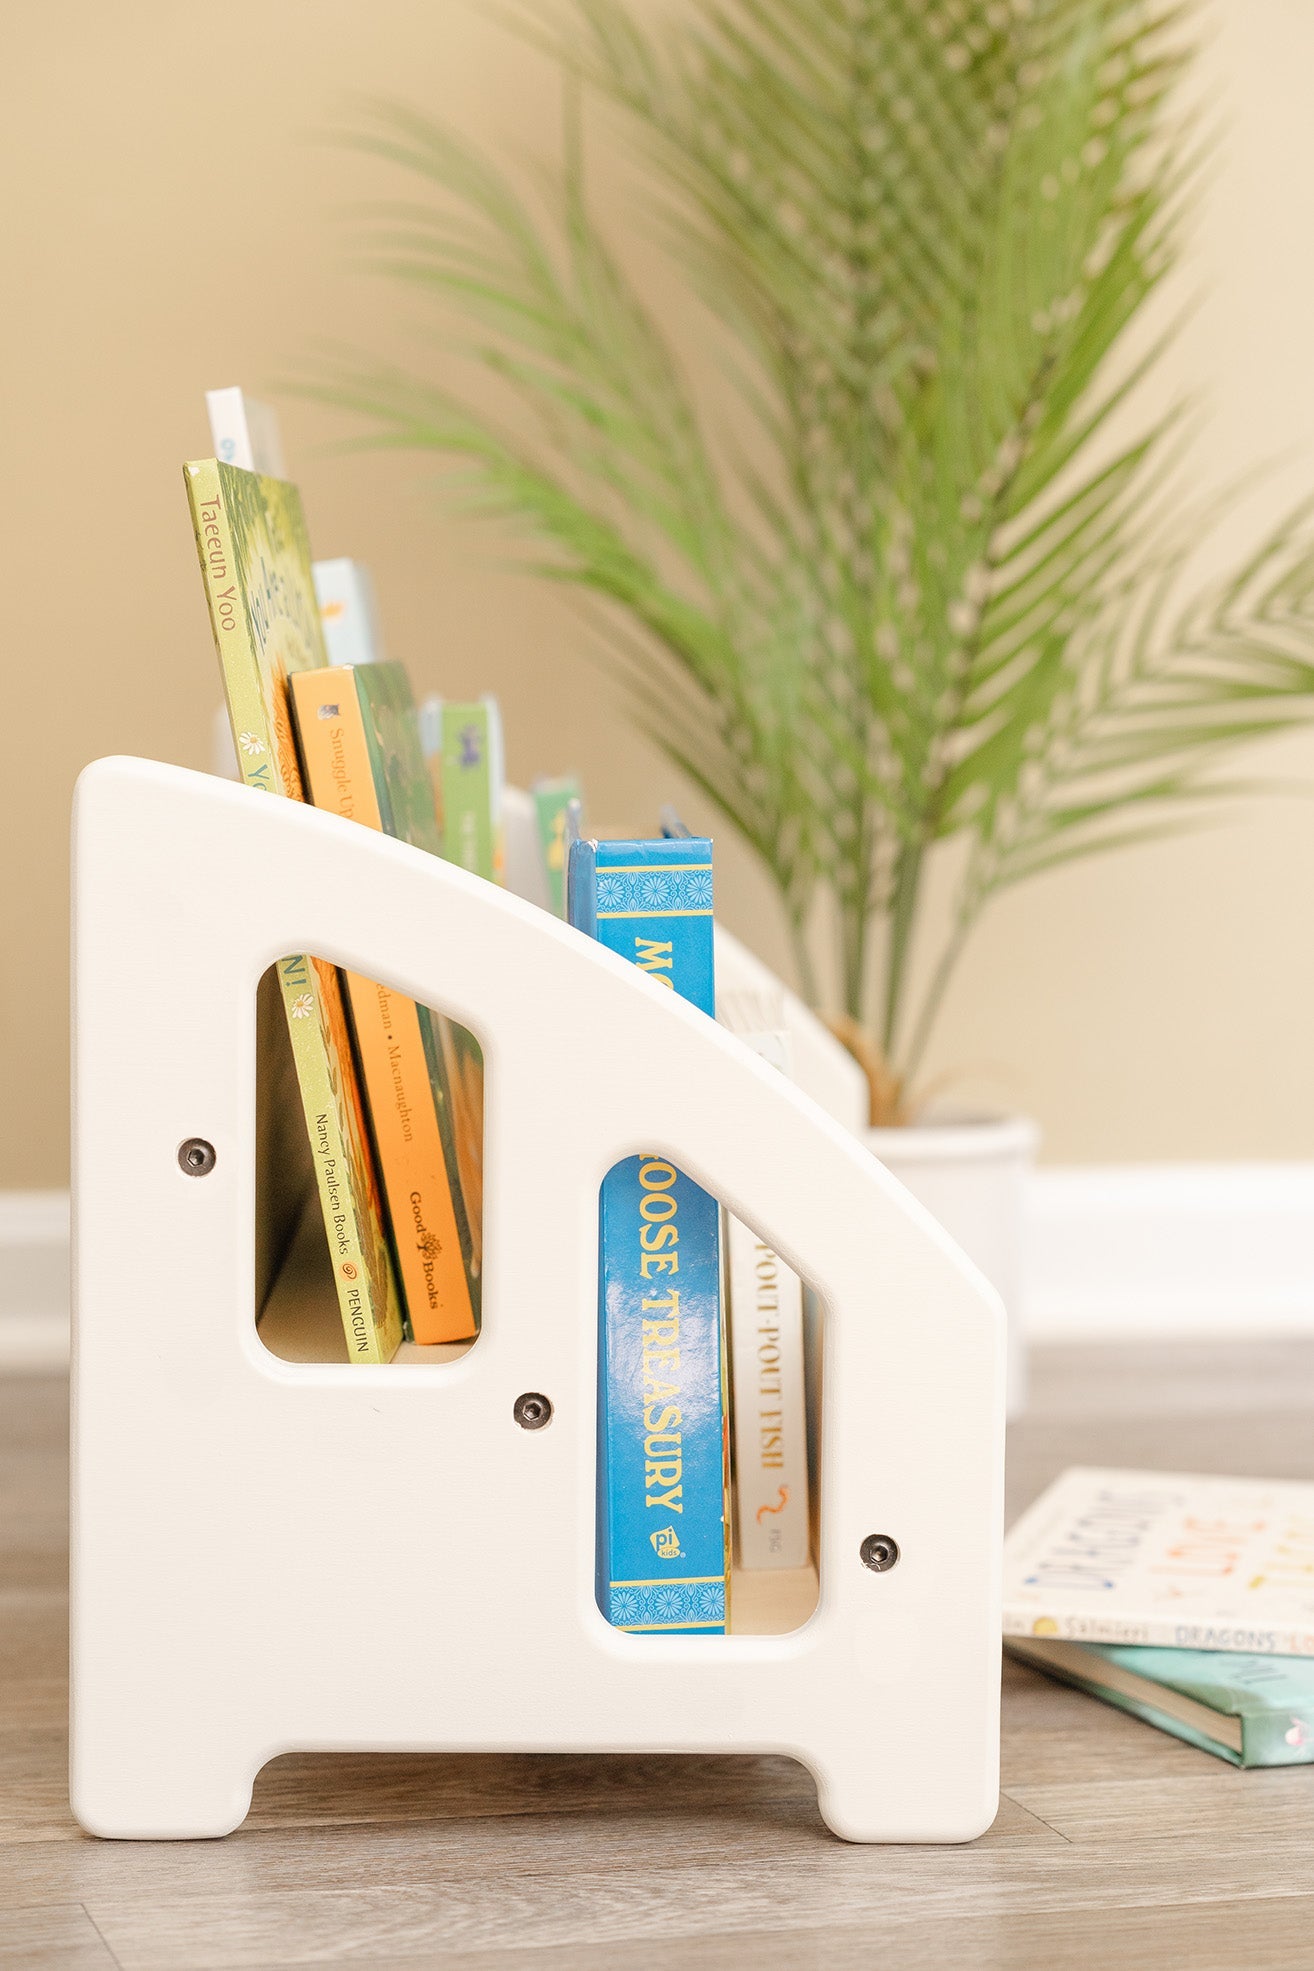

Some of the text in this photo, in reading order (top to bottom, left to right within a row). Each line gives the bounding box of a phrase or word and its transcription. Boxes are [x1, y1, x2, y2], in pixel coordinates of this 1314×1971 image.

[200, 494, 237, 631] Taeeun Yoo
[330, 728, 352, 792] Snuggle
[388, 1045, 414, 1142] Macnaughton
[315, 1113, 350, 1255] Nancy Paulsen Books
[410, 1191, 440, 1310] Good Books
[346, 1288, 369, 1353] PENGUIN
[638, 1154, 684, 1514] OOSE TREASURY
[655, 1527, 673, 1552] pi
[661, 1549, 677, 1557] kids
[1175, 1624, 1277, 1651] DRAGONS
